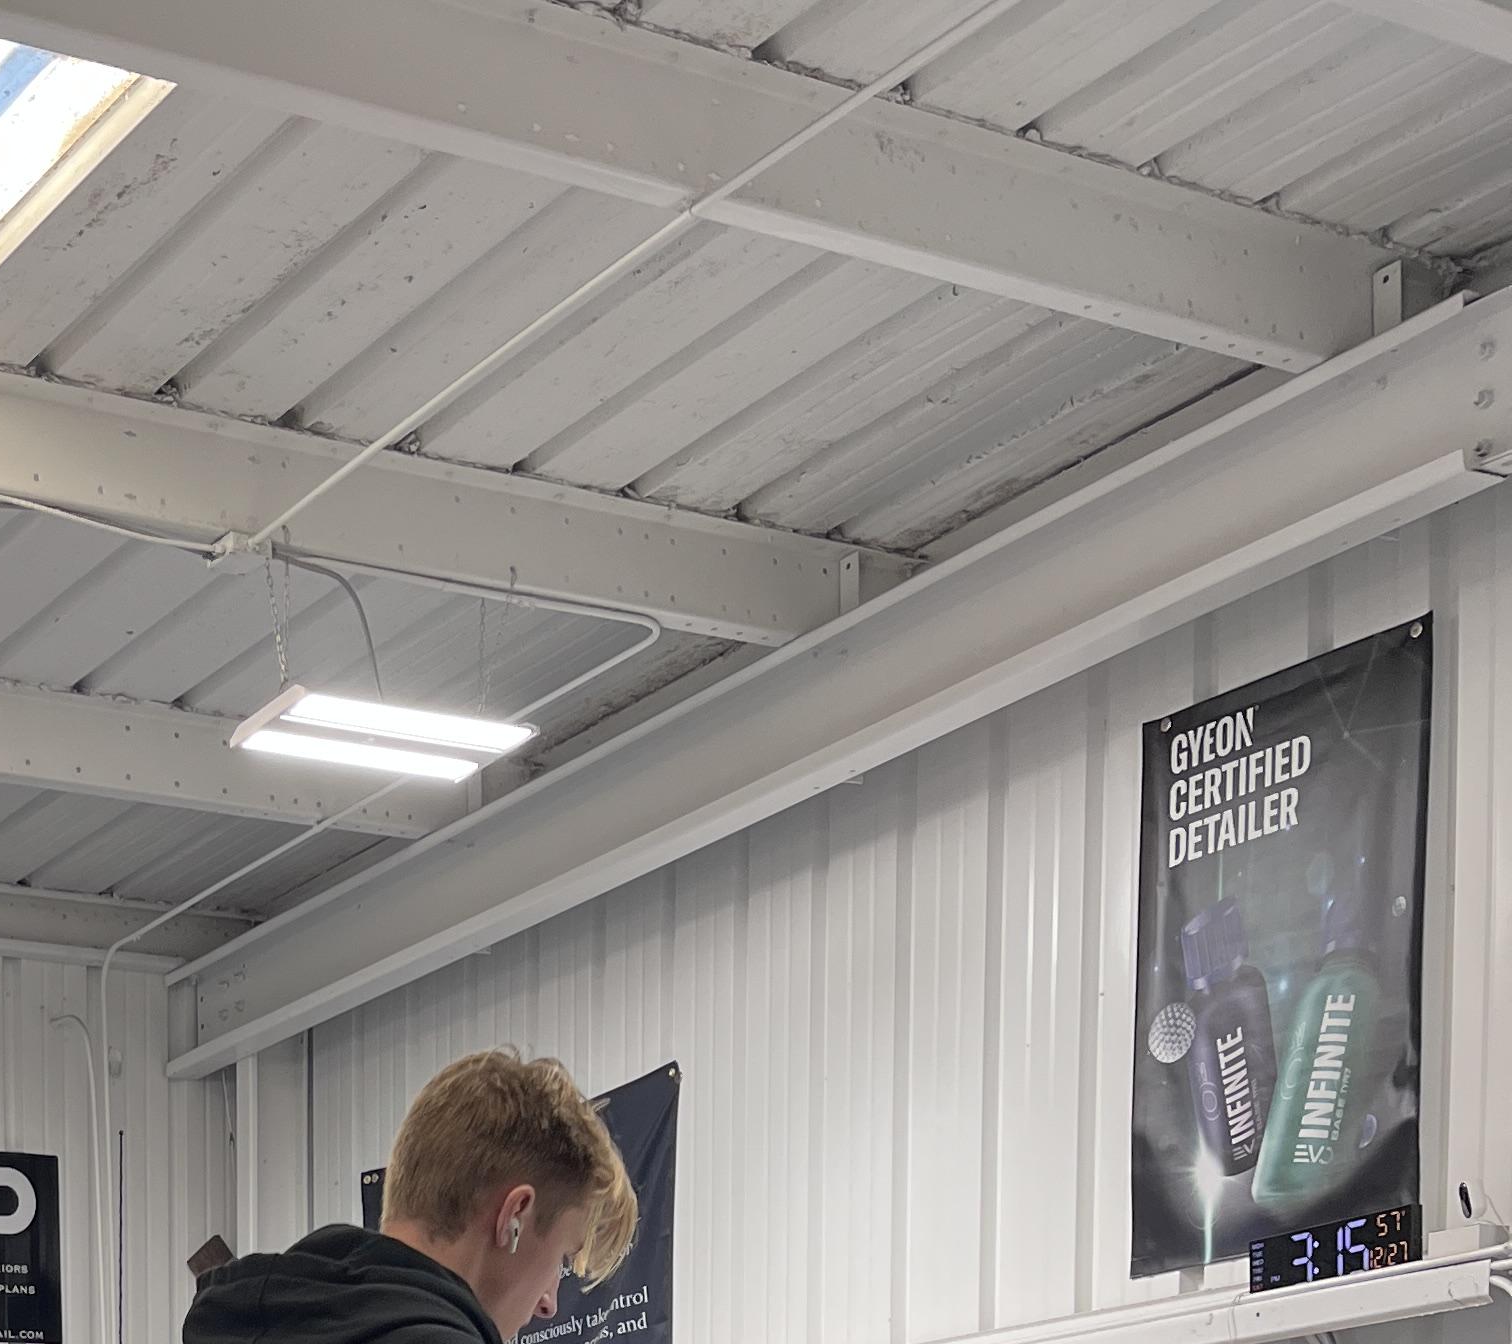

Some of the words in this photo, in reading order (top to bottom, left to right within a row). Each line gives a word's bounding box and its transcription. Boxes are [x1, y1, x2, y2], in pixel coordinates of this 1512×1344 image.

[1169, 735, 1312, 822] CERTIFIED
[1171, 707, 1254, 775] GYEON
[1168, 787, 1299, 868] DETAILER
[1216, 1026, 1256, 1145] INFINITE
[1298, 994, 1356, 1139] INFINITE
[1290, 1218, 1370, 1282] 3:15
[616, 1311, 648, 1335] and
